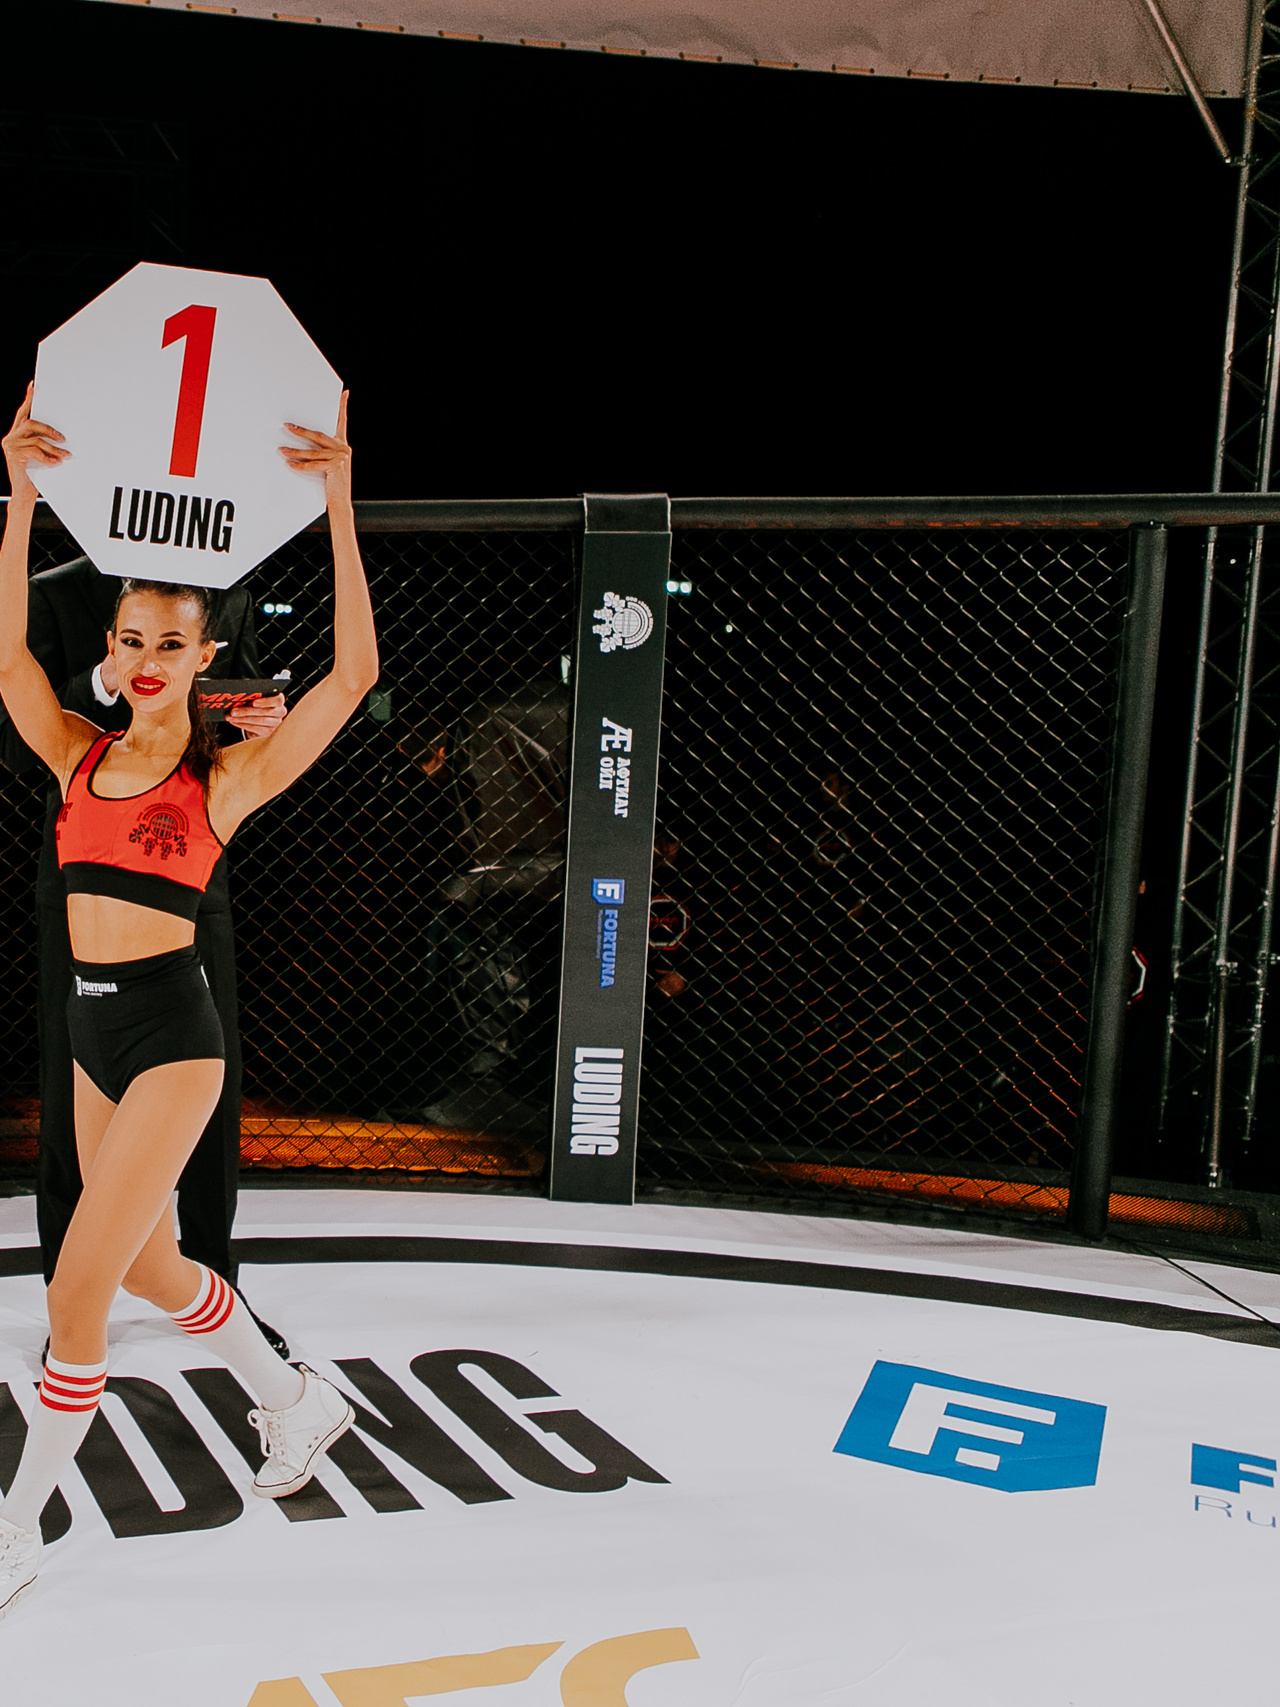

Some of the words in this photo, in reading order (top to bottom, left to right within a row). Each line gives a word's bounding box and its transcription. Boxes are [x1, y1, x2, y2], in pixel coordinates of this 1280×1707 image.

[162, 305, 216, 478] 1
[109, 487, 234, 553] LUDING
[599, 757, 616, 790] ОЙЛ
[600, 909, 618, 988] FORTUNA
[82, 981, 118, 993] FORTUNA
[570, 1047, 624, 1155] LUDING
